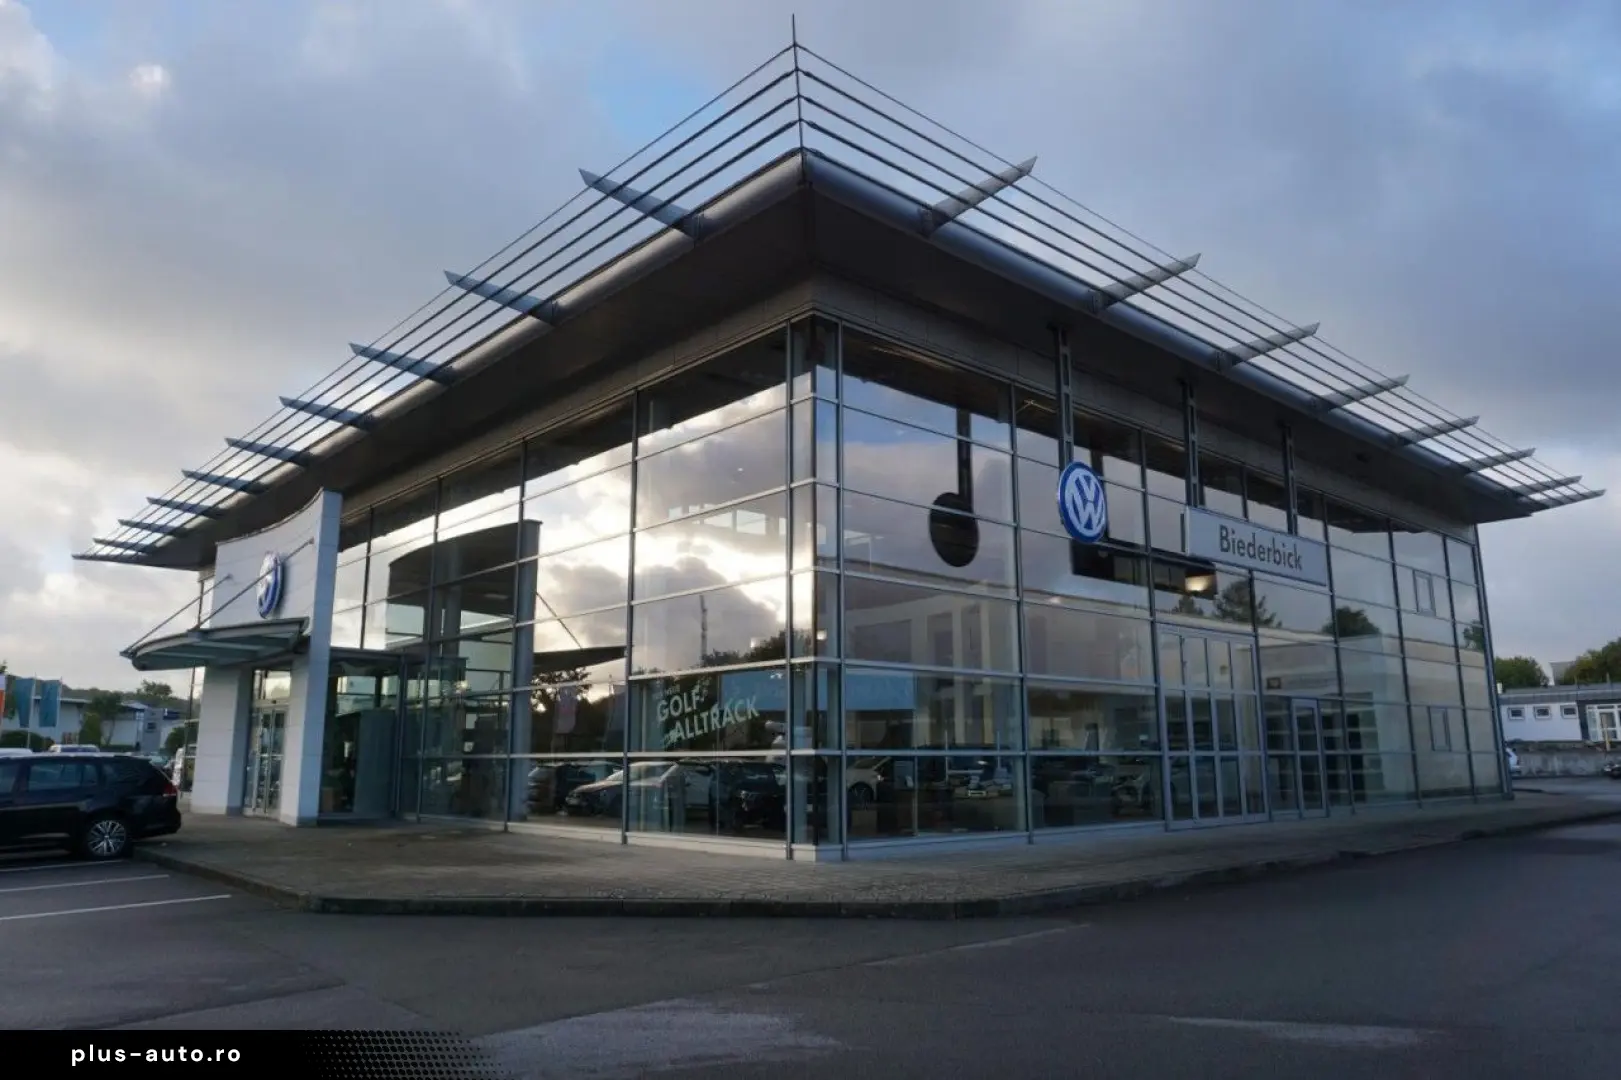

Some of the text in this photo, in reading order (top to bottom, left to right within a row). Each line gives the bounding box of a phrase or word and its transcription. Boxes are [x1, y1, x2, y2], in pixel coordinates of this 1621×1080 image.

[1063, 466, 1106, 539] VW
[1219, 524, 1302, 571] Biederbick
[656, 684, 701, 721] GOLF
[673, 695, 760, 742] ALLTRACK
